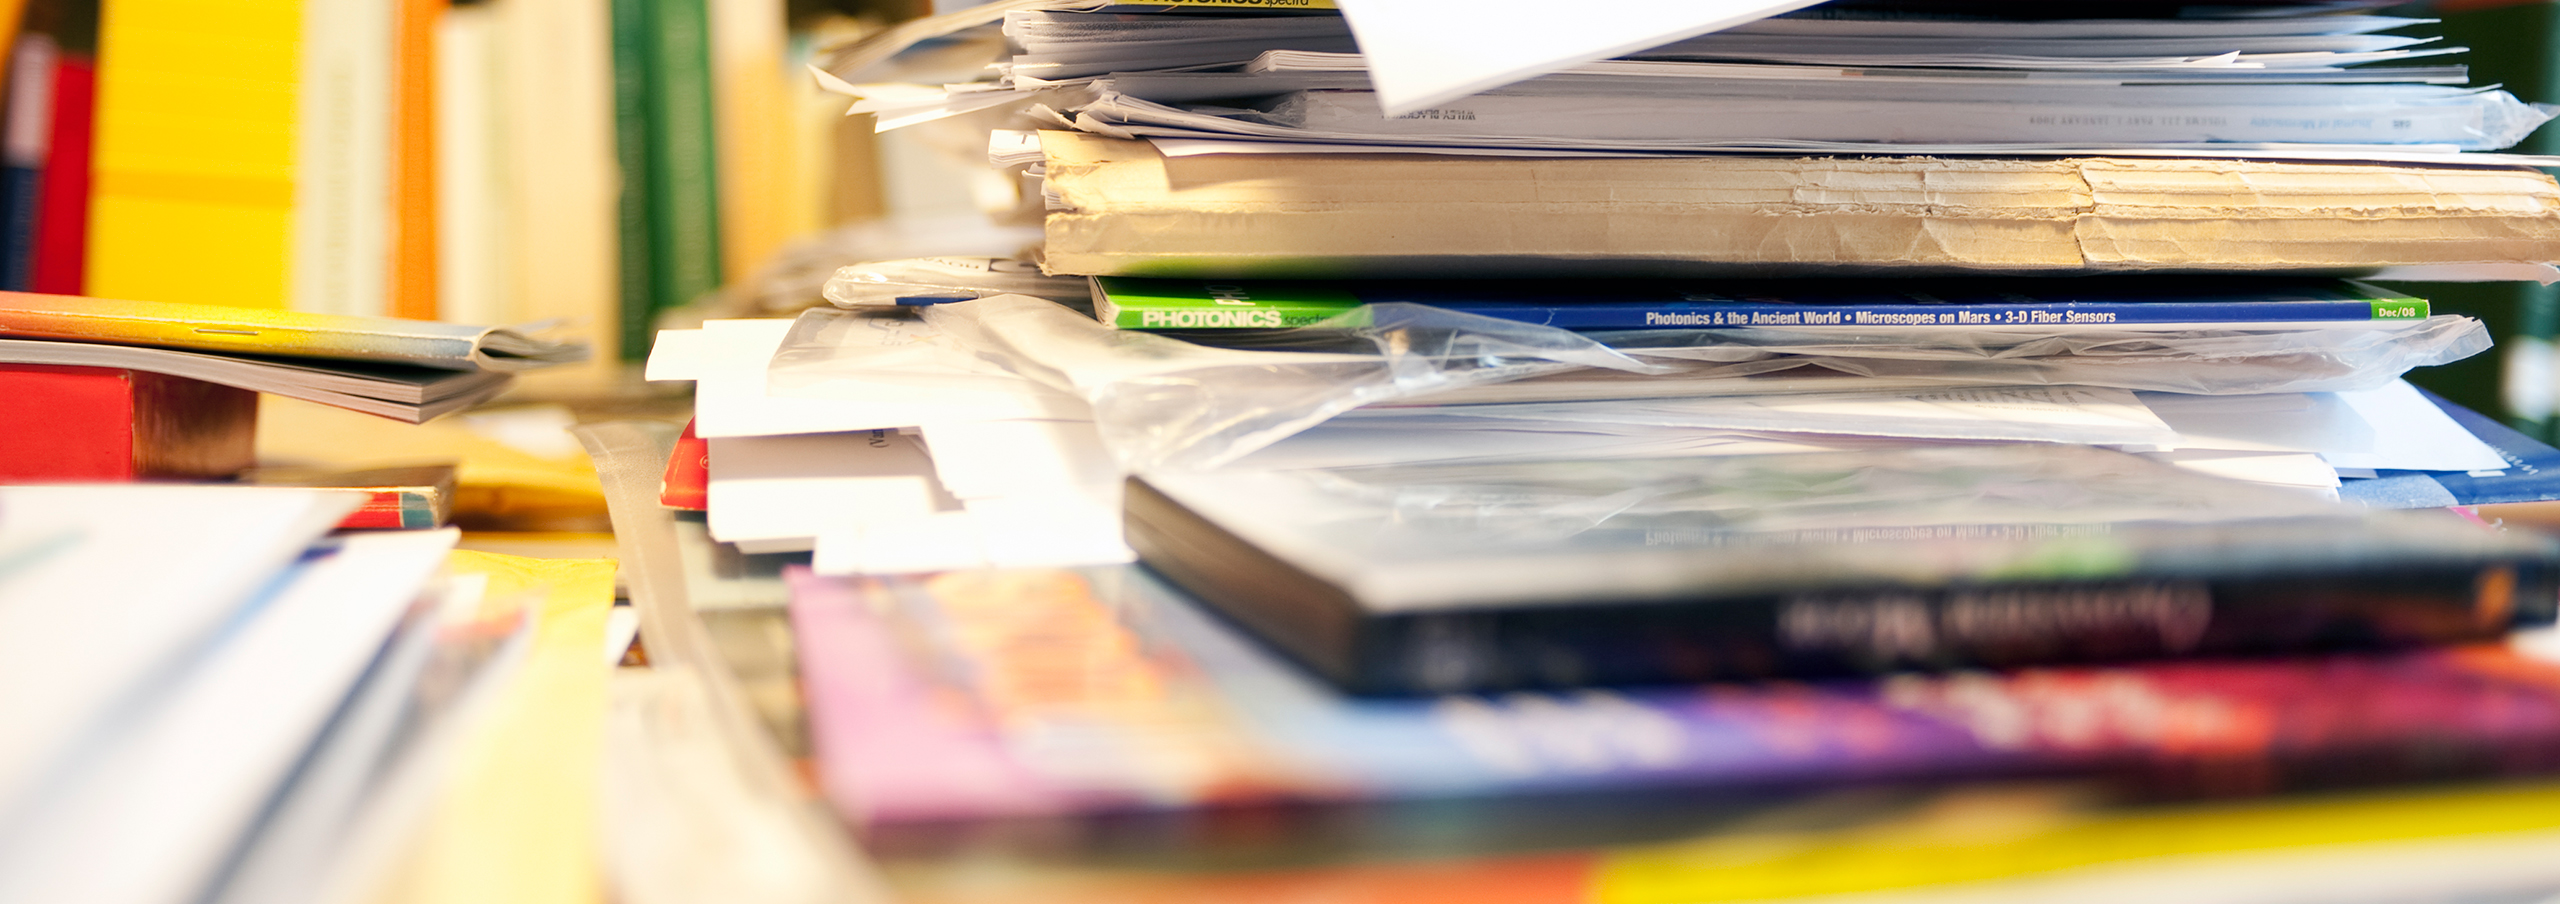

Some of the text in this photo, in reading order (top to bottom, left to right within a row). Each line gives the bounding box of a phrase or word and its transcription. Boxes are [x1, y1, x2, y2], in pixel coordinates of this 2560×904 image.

[1443, 110, 1476, 120] WILEY
[1142, 309, 1282, 328] PHOTONICS
[1646, 310, 2116, 326] Photonics & the Ancient World Microscopes on Mars 3-D Fiber Sensors
[2378, 307, 2416, 317] Dec/08
